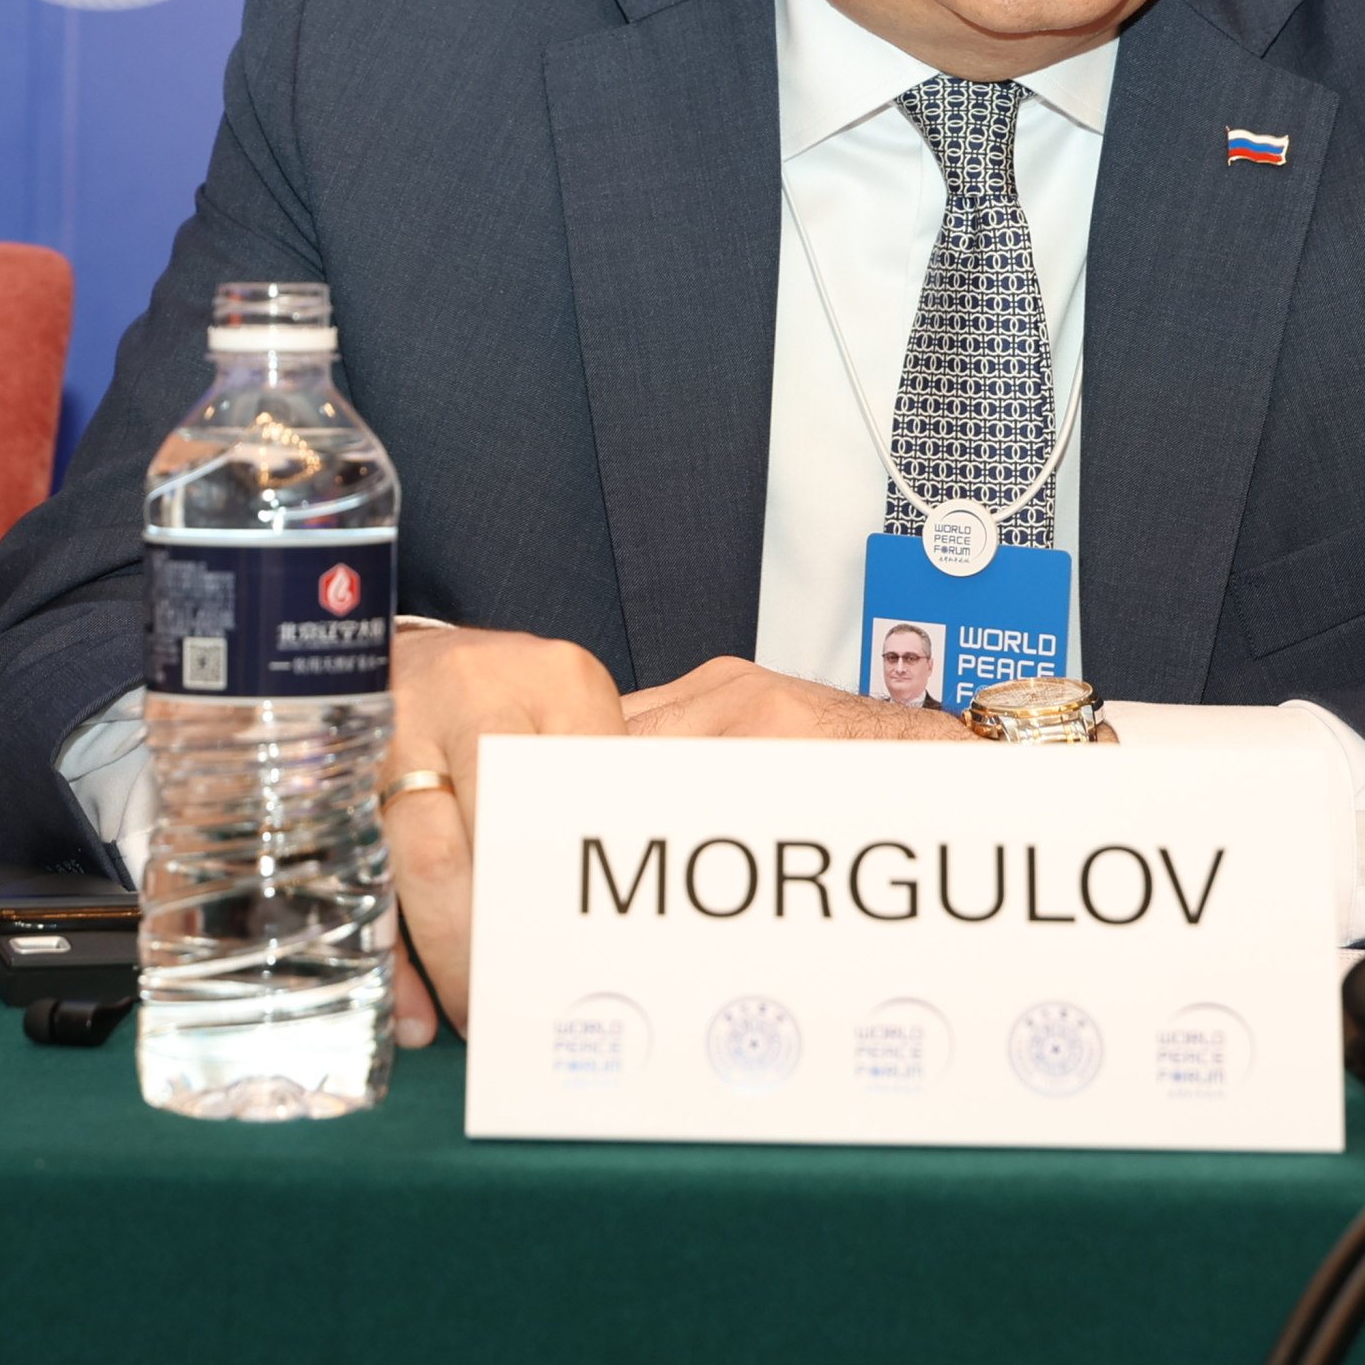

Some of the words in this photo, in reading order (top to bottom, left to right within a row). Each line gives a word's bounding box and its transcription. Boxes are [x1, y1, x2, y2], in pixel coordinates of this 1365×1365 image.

[934, 524, 971, 535] WORLD
[934, 534, 971, 545] PEACE
[959, 625, 1056, 656] WORLD
[580, 838, 1226, 926] MORGULOV
